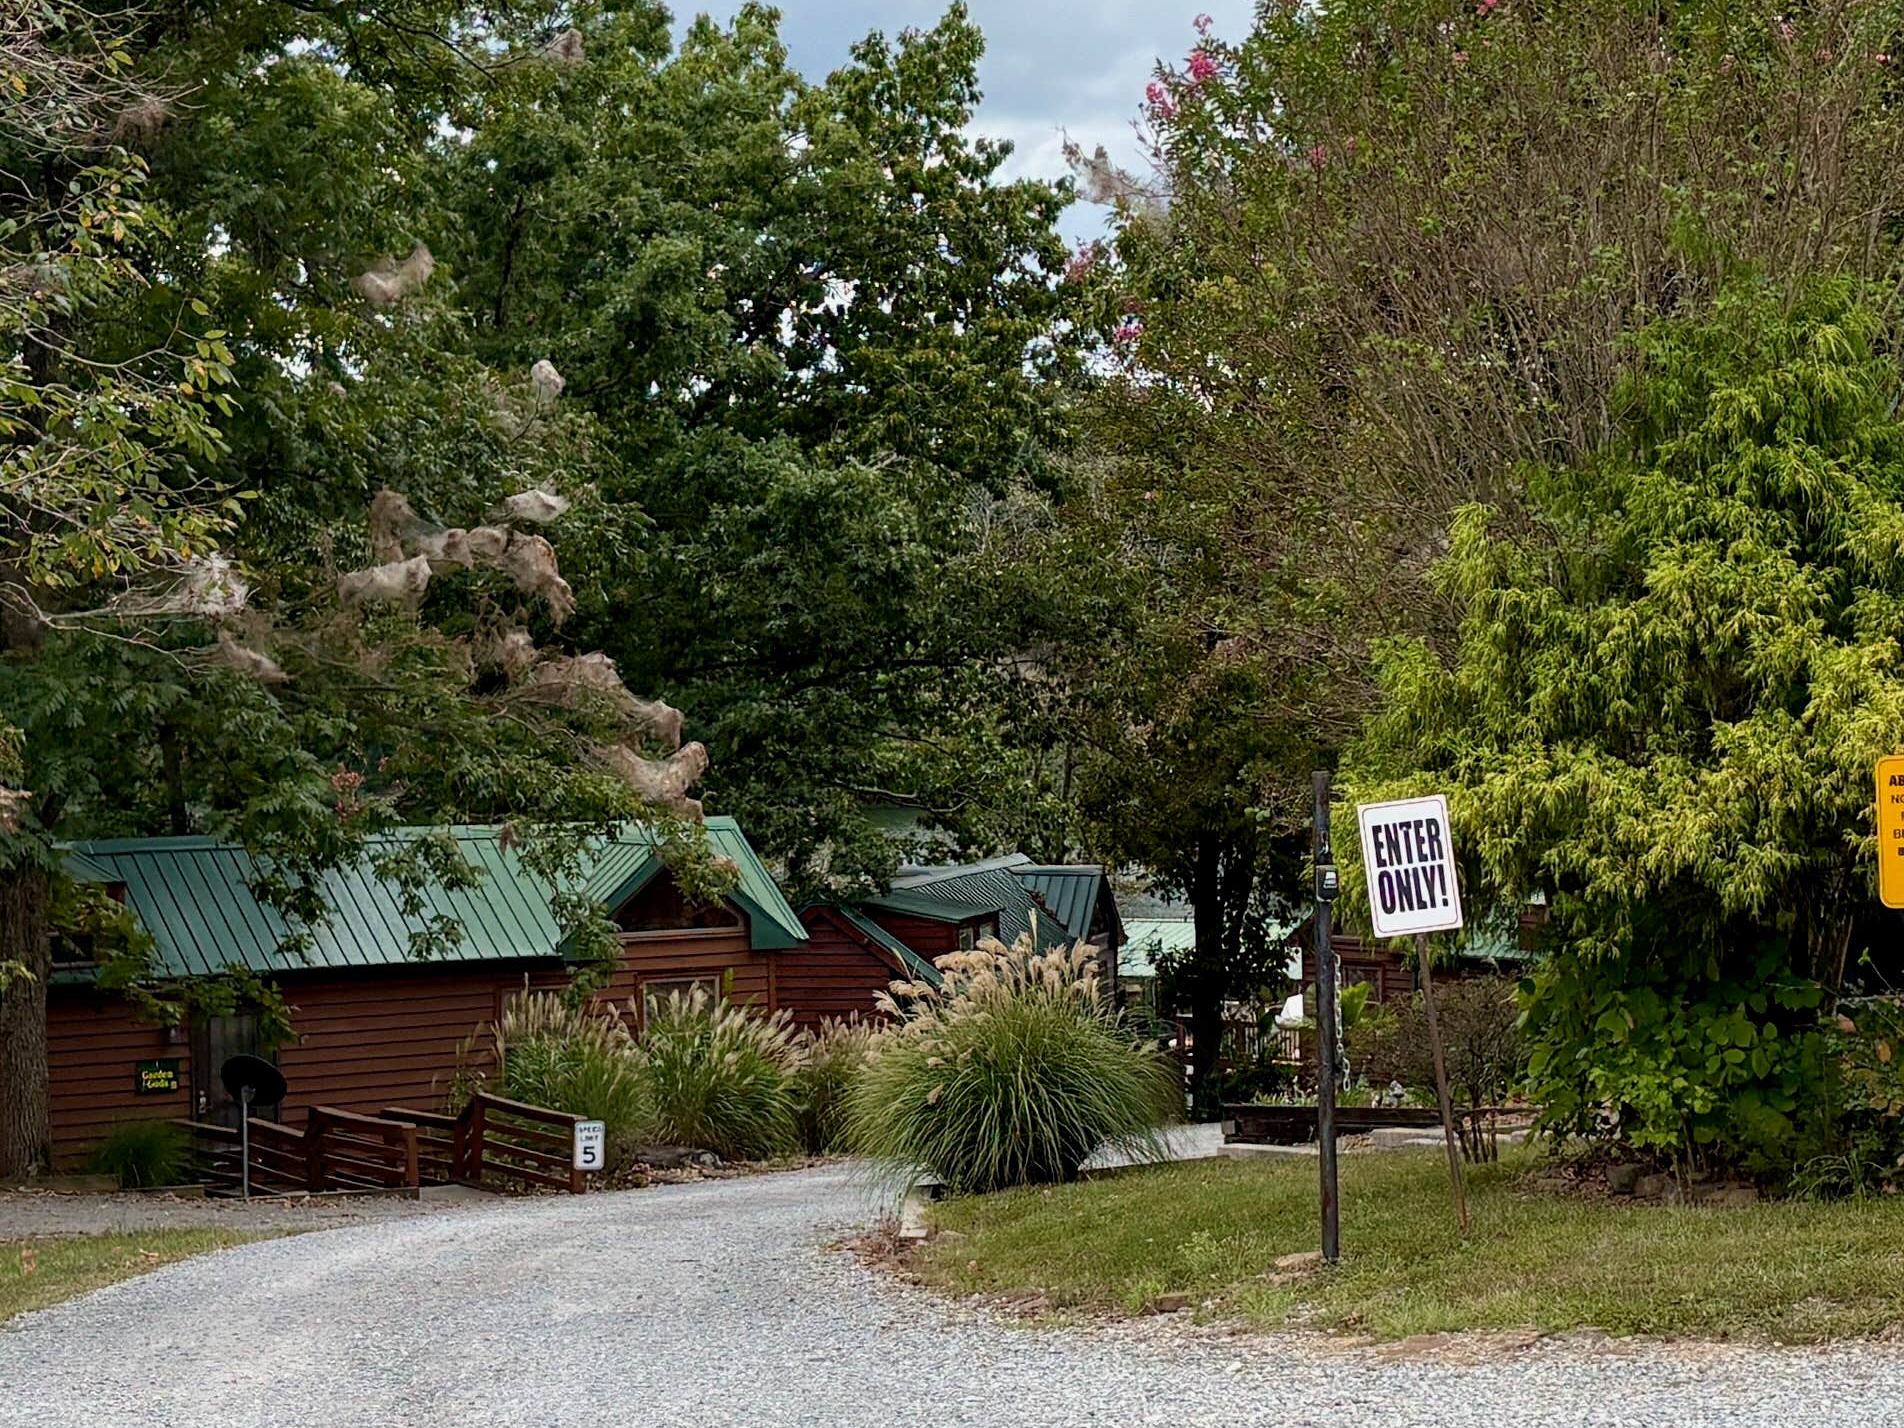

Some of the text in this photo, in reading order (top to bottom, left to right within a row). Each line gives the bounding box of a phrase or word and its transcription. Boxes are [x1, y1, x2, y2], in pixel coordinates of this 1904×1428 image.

[1371, 818, 1444, 868] ENTER
[1378, 864, 1448, 914] ONLY!
[582, 1146, 596, 1164] 5
